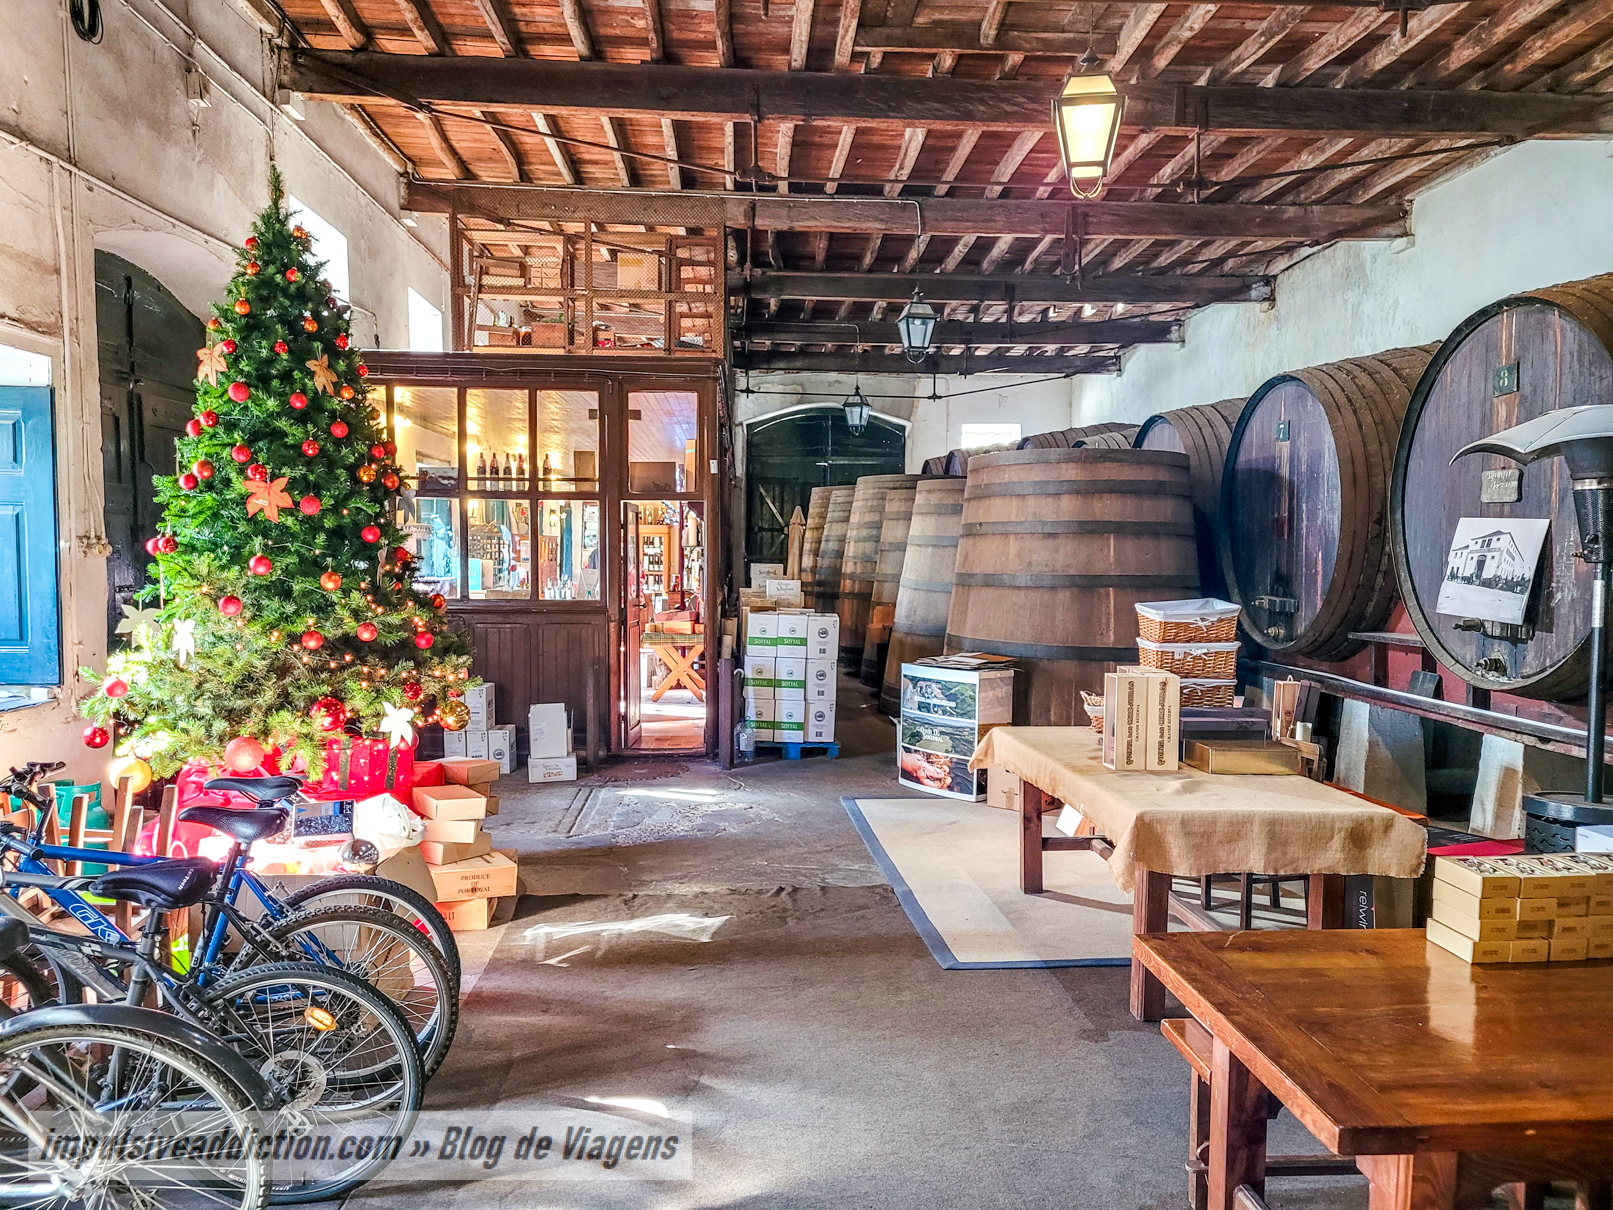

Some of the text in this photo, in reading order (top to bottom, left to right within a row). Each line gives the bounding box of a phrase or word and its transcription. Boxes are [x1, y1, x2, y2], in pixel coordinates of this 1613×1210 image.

[1499, 369, 1509, 387] 8
[460, 873, 491, 881] PRODUCE
[458, 886, 491, 894] PORTUGAL
